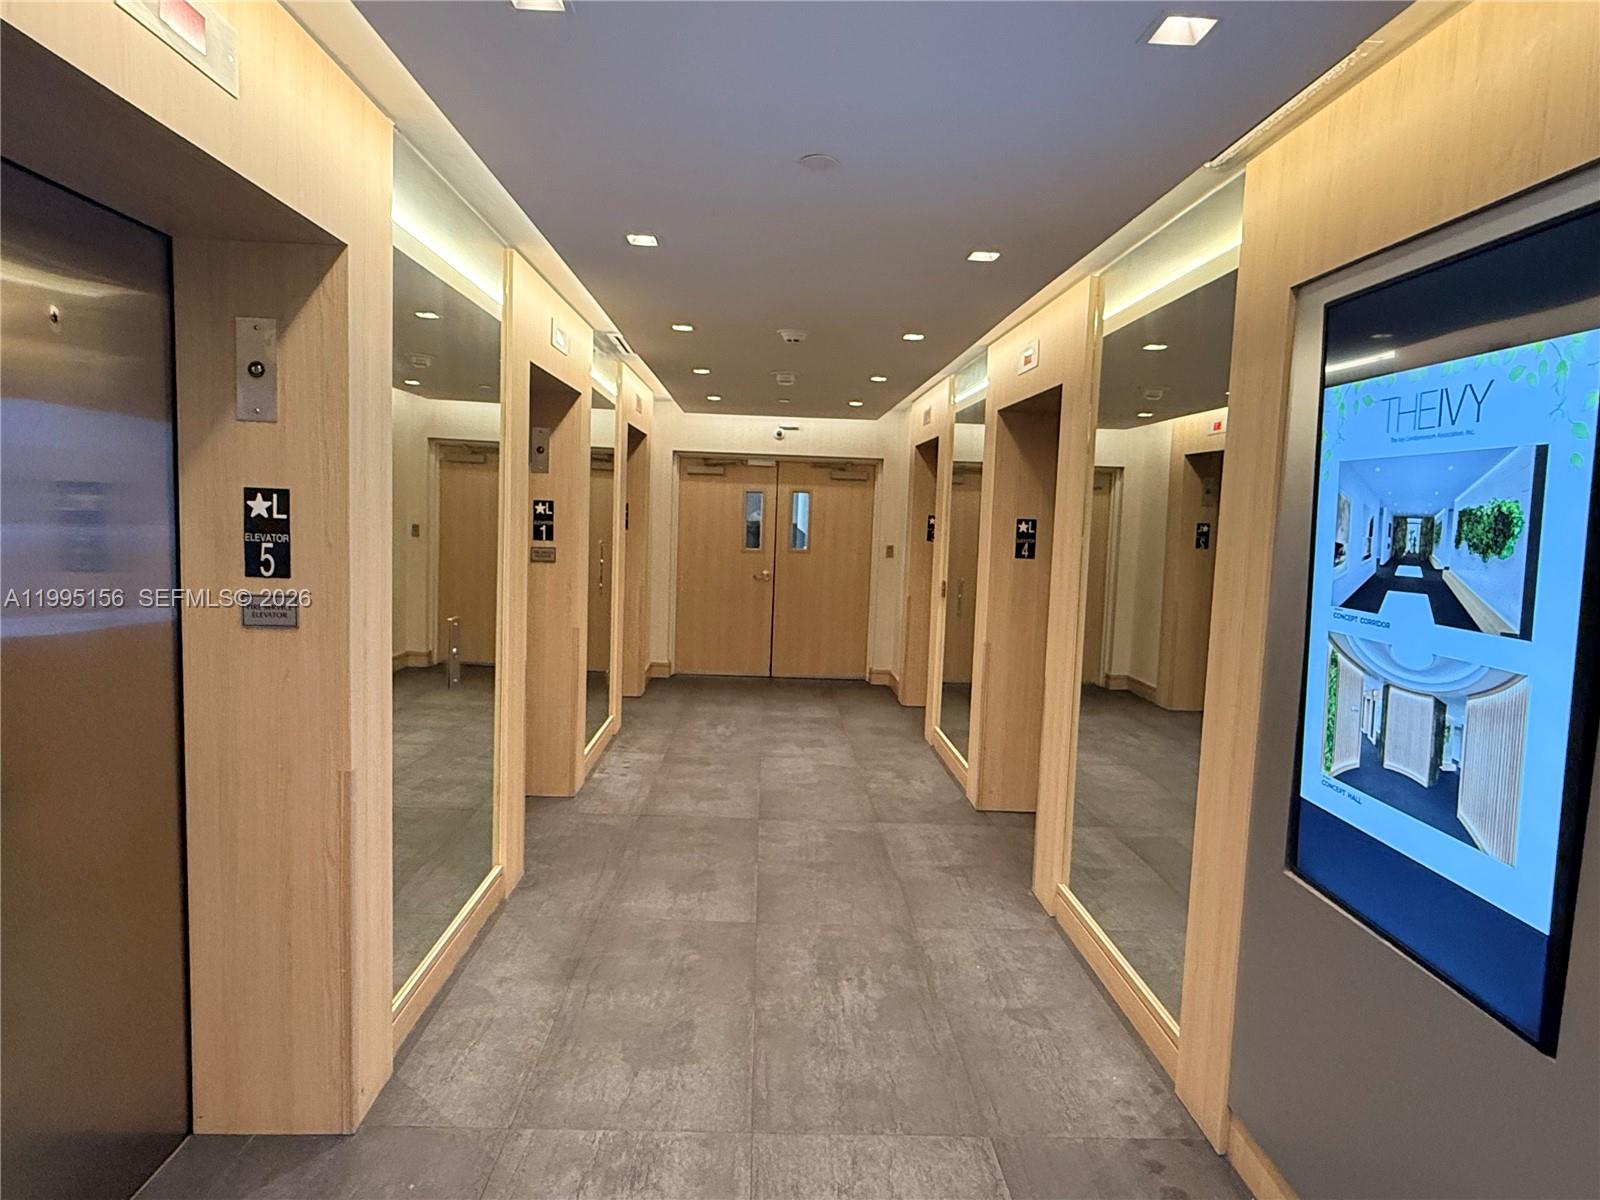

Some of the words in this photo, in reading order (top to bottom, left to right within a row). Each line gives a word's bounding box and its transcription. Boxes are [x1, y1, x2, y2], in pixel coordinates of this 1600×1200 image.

[244, 532, 290, 543] ELEVATOR
[539, 524, 546, 540] 1
[1021, 542, 1029, 558] 4
[259, 542, 276, 577] 5
[1360, 616, 1391, 629] CORRIDOR
